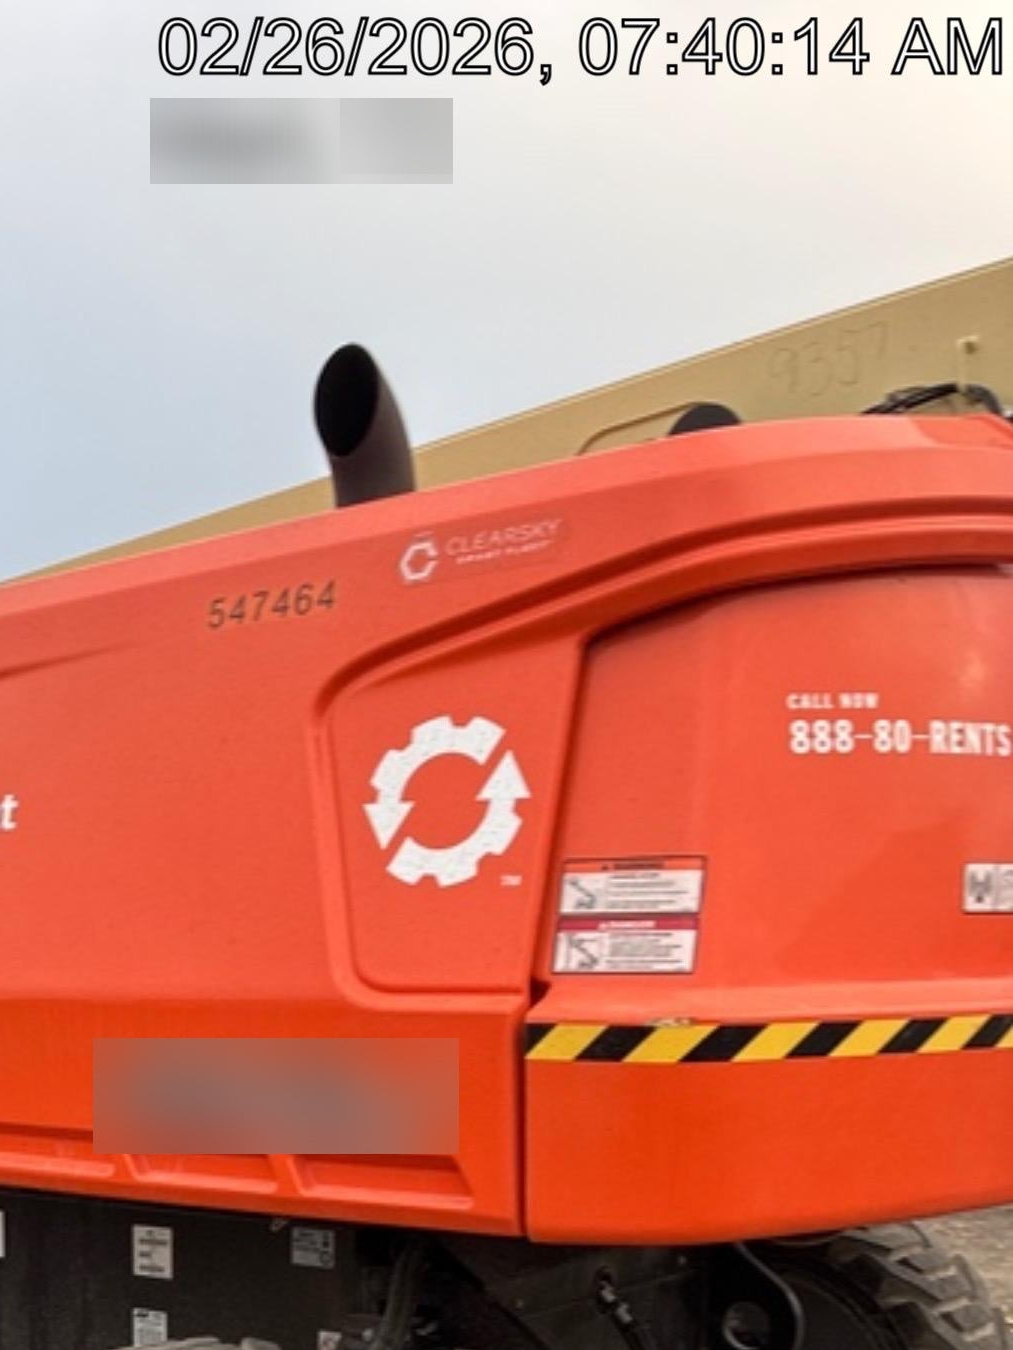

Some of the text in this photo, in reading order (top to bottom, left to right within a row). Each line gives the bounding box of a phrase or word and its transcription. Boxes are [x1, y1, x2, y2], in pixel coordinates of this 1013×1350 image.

[208, 580, 336, 629] 547464
[786, 693, 834, 709] CALL
[790, 719, 1012, 756] 888-80-RENTS
